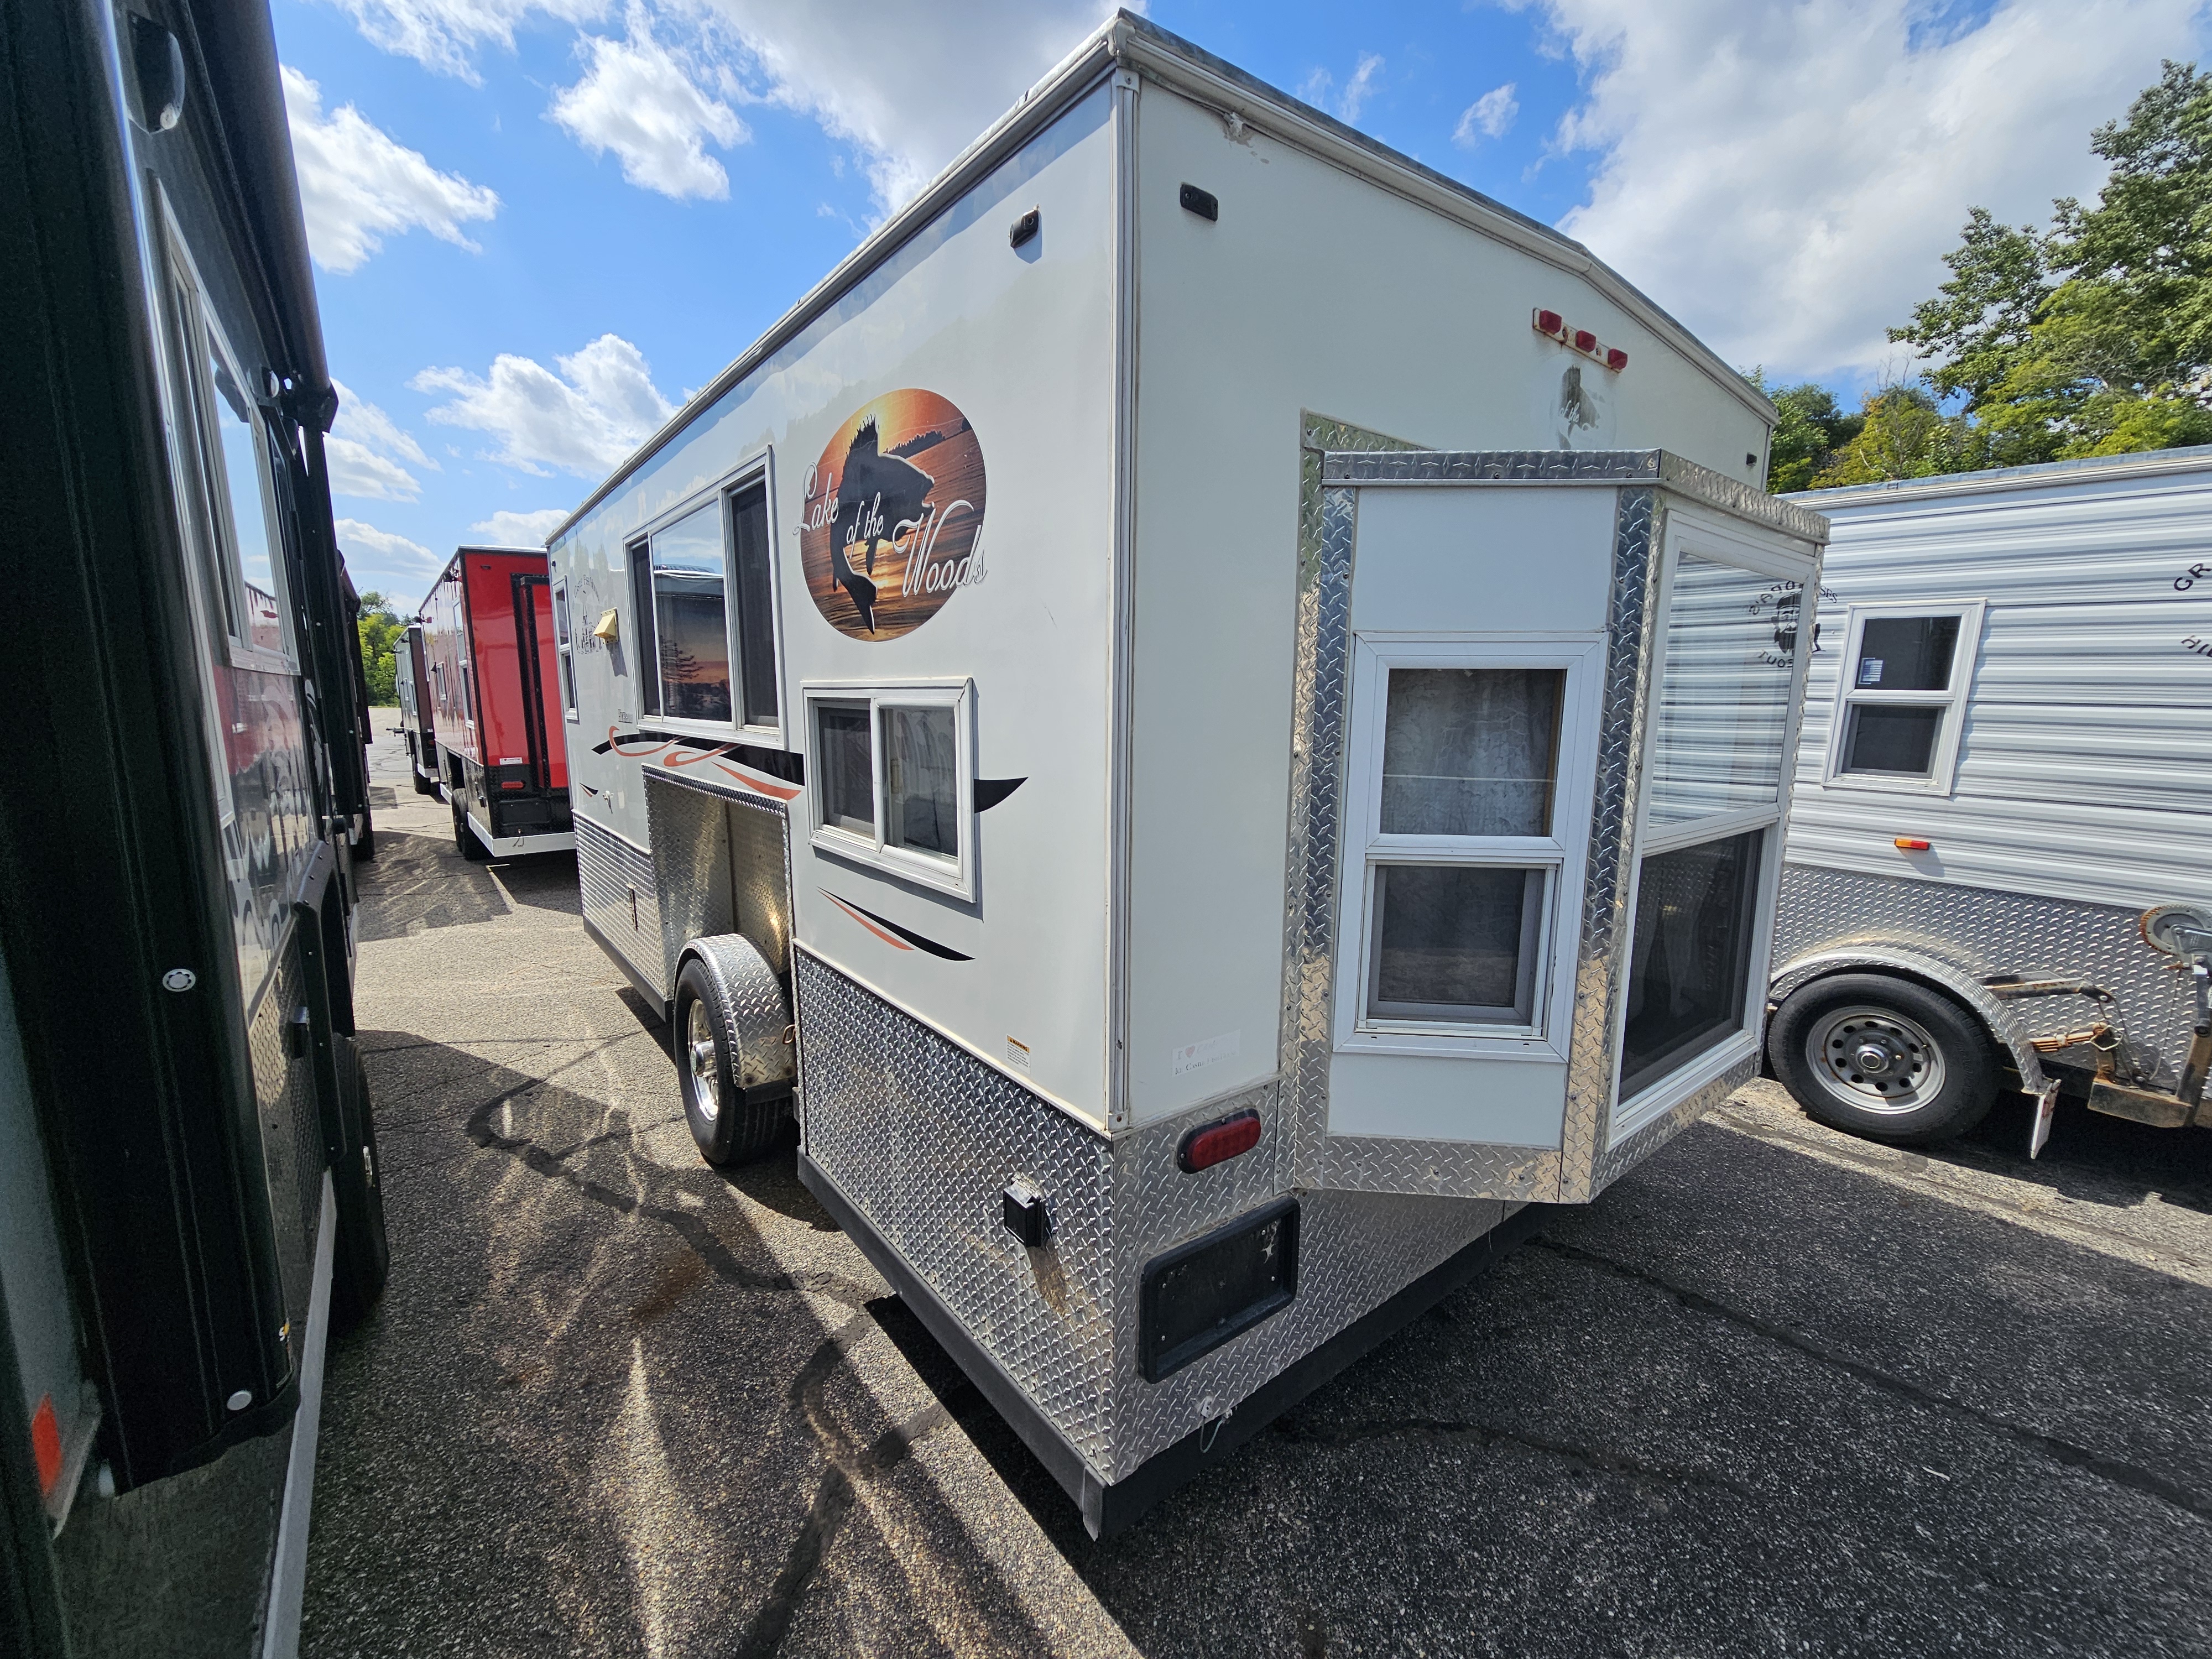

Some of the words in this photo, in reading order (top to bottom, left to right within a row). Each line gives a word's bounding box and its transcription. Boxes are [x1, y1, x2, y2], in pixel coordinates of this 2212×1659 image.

[1559, 399, 1572, 418] of
[1569, 401, 1580, 422] the
[792, 462, 839, 535] Lake
[846, 499, 865, 560] of
[864, 492, 884, 539] the
[891, 499, 989, 598] Woods
